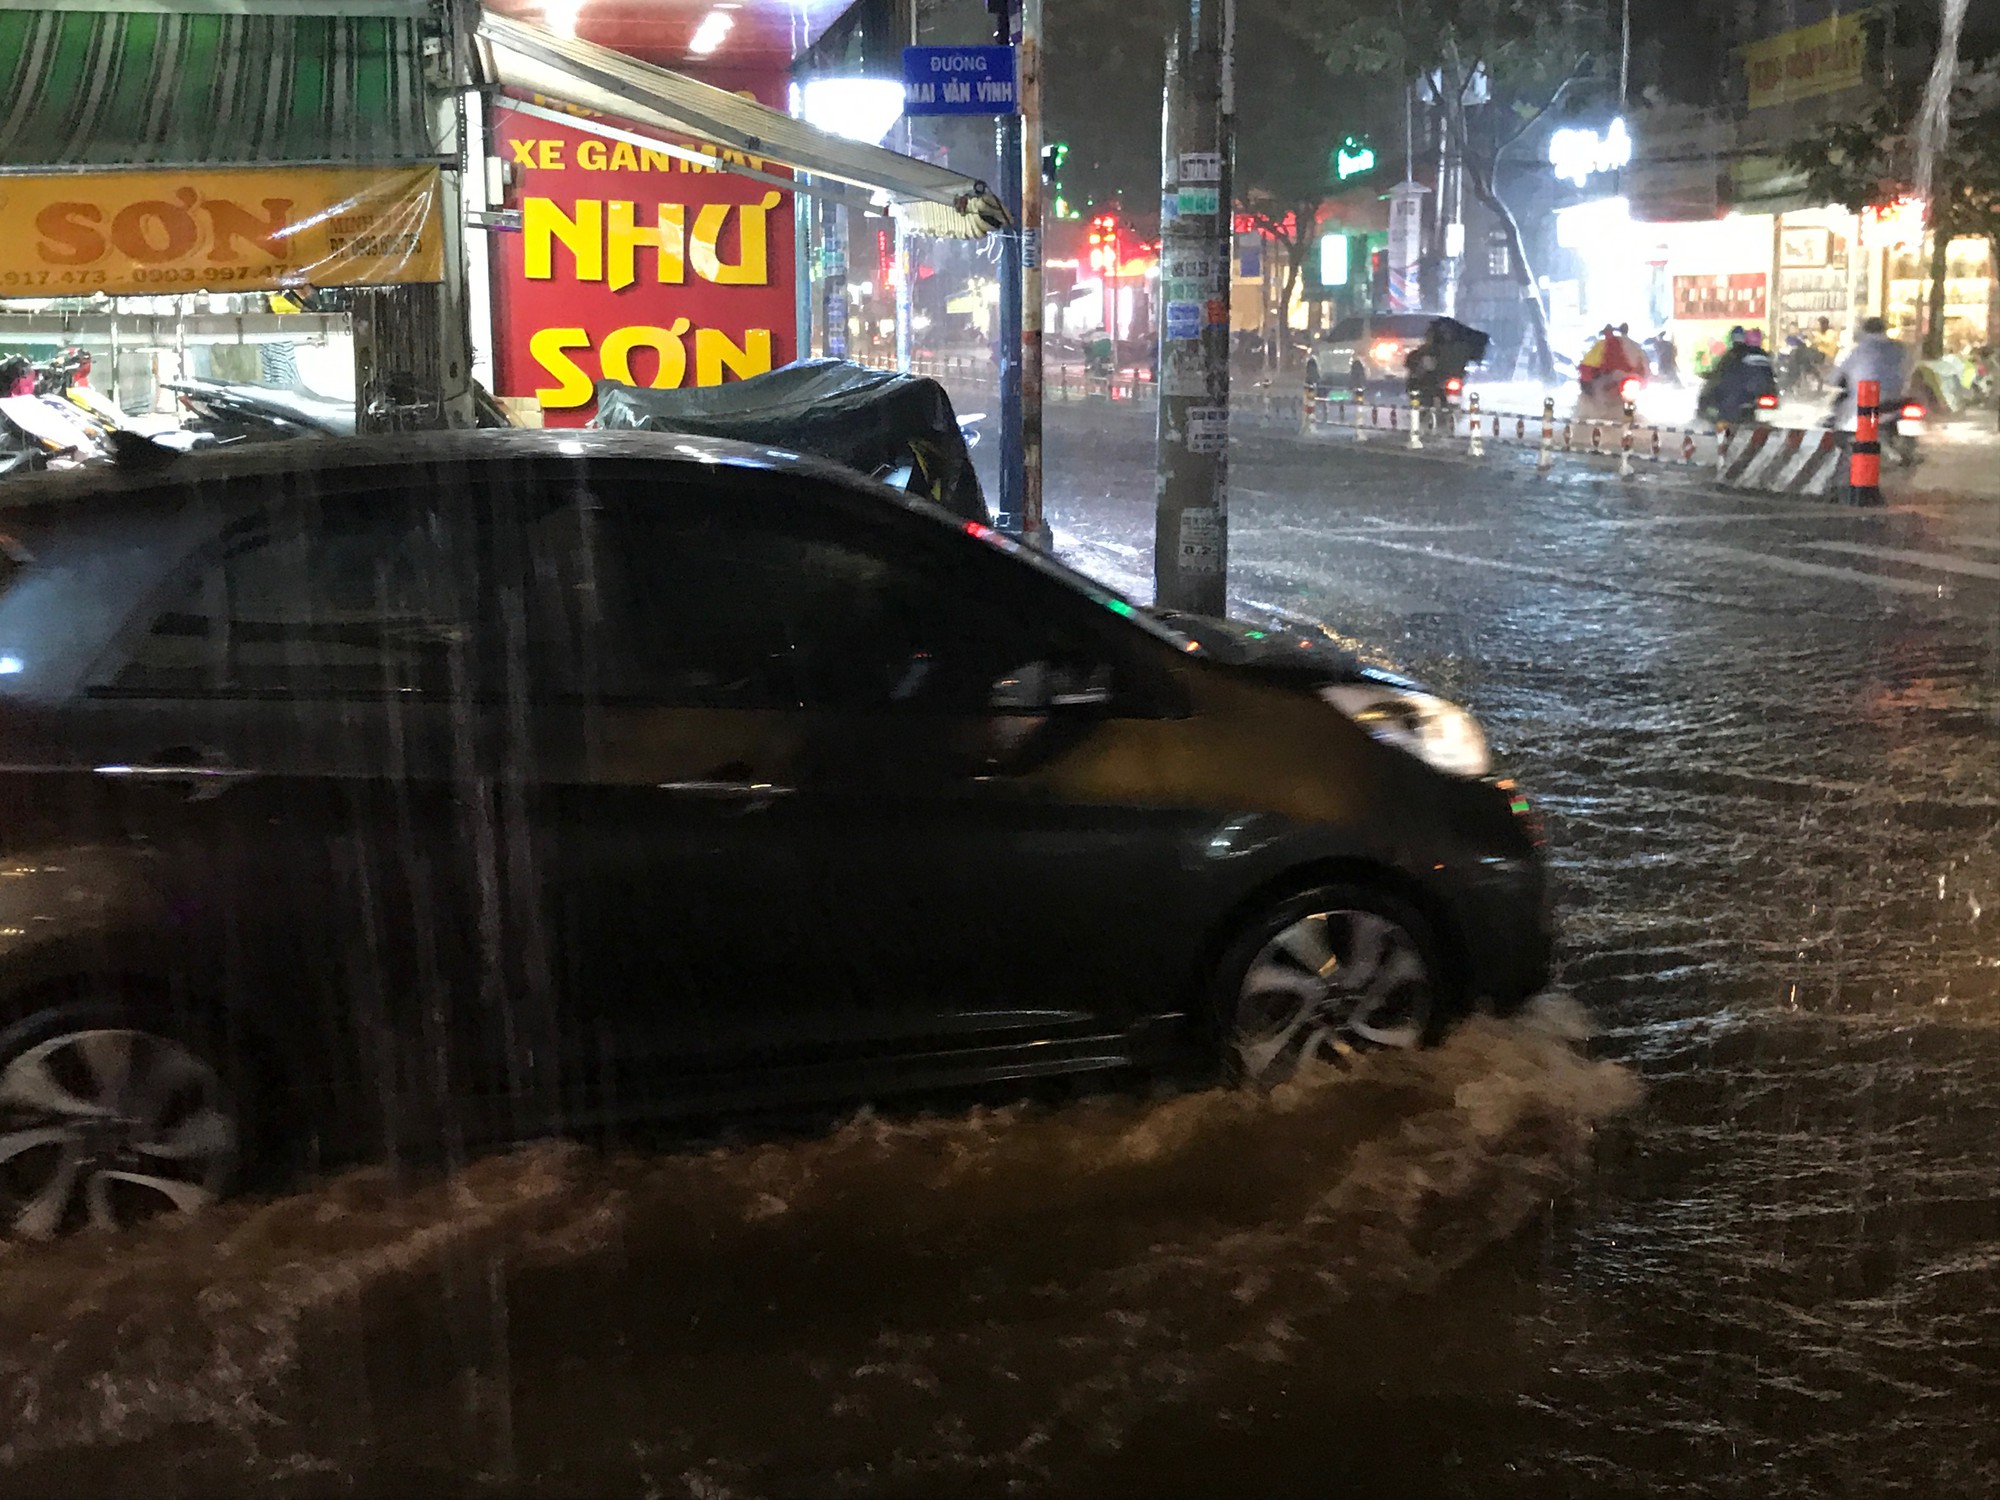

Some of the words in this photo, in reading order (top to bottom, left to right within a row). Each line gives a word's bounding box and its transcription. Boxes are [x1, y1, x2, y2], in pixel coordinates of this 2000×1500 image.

[906, 82, 935, 103] MAI
[509, 139, 565, 170] XE
[35, 187, 294, 265] SƠN
[524, 191, 782, 292] NHƯ
[131, 264, 304, 285] 0903.997.47
[530, 317, 772, 408] SƠN
